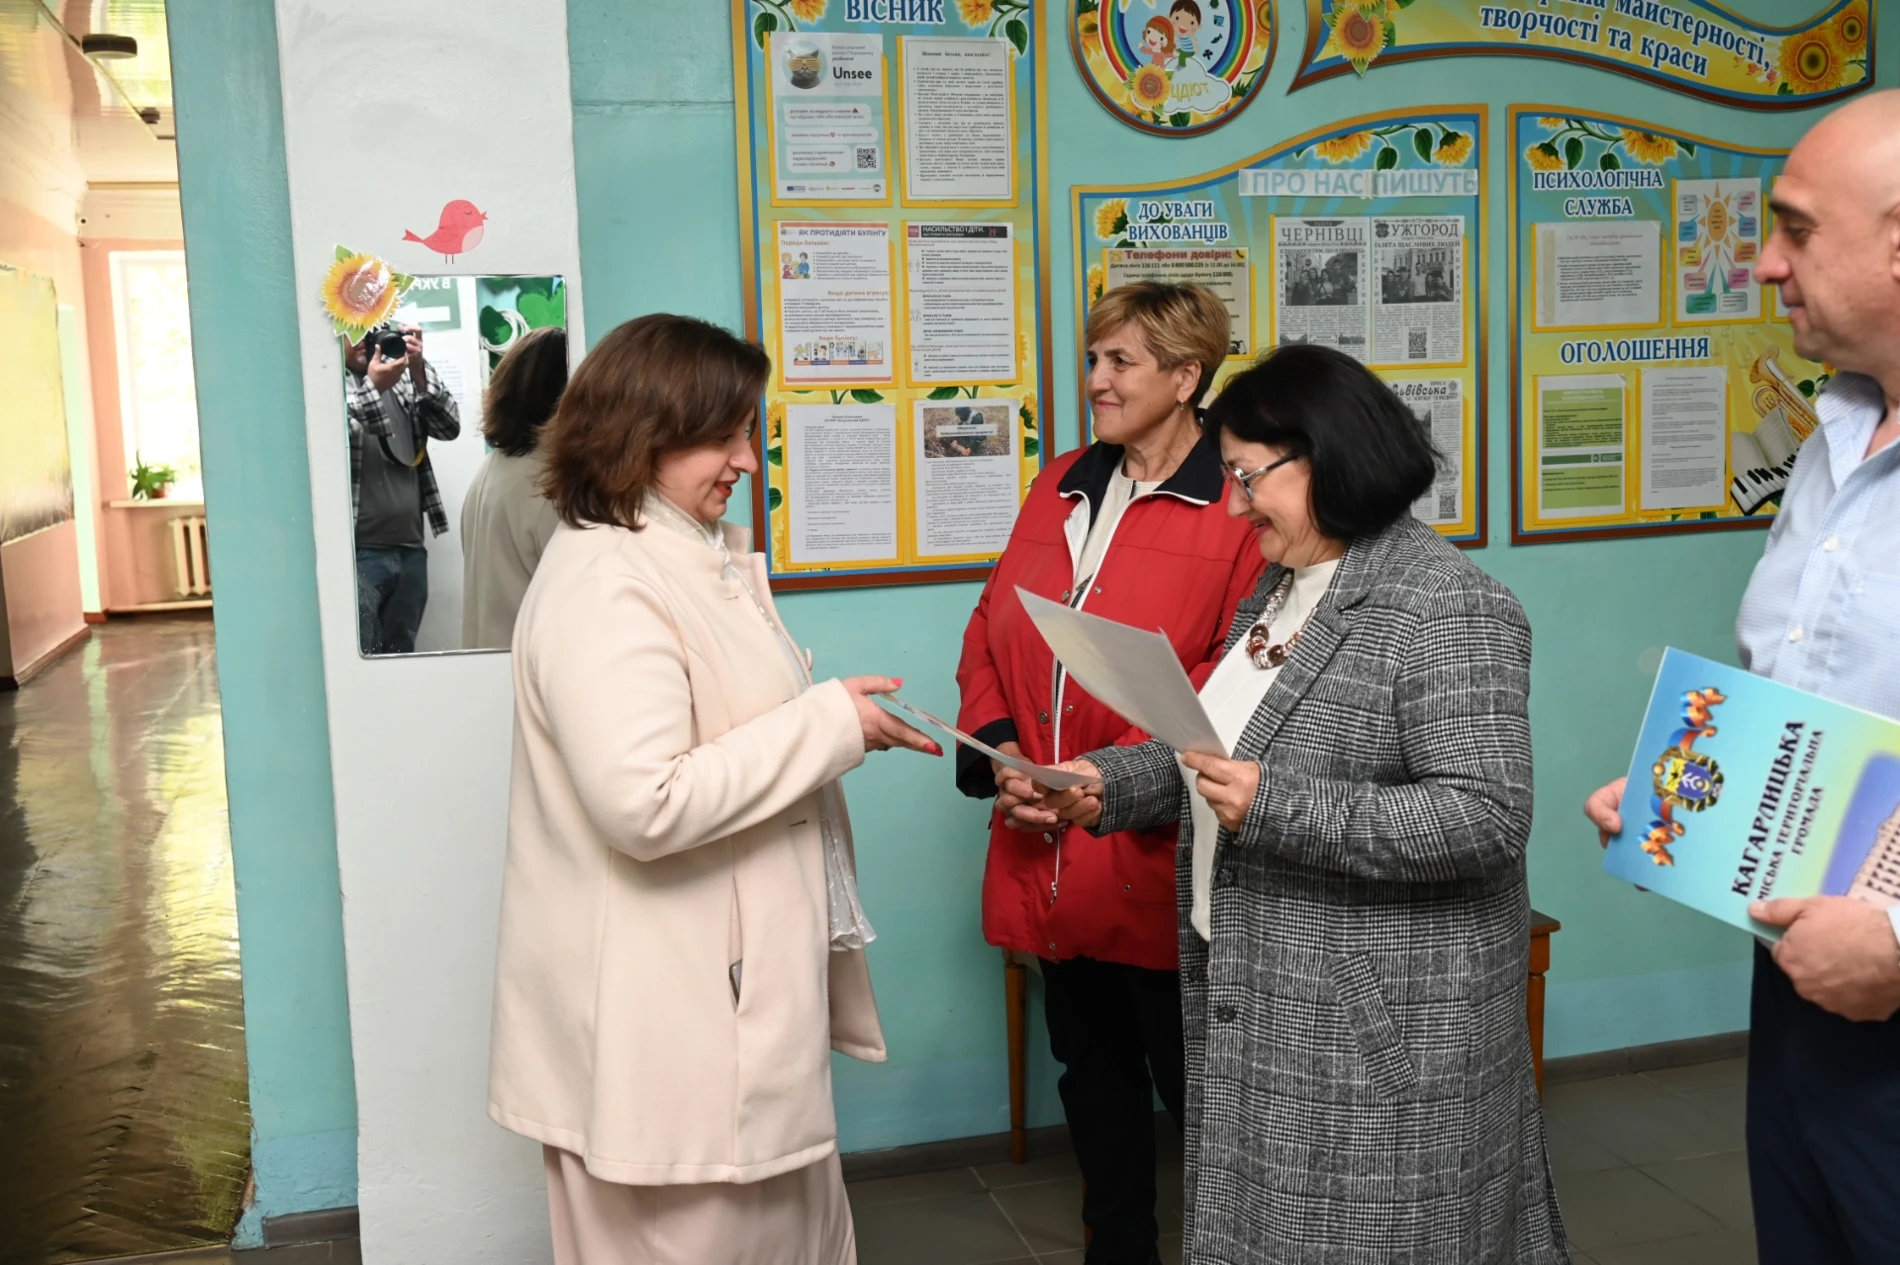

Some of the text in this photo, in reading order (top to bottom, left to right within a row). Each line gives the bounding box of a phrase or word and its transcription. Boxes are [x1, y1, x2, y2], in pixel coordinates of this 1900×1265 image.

[846, 0, 944, 22] ВІСНИК
[1481, 7, 1708, 76] творчості та краси
[832, 66, 873, 79] Unsee
[1171, 82, 1210, 103] ЦДЮТ
[1252, 171, 1478, 194] ПРО НАС ПИШУТЬ
[1533, 170, 1663, 189] ПСИХОЛОГІЧНА
[1138, 202, 1213, 220] ДО УВАГИ
[1564, 198, 1634, 216] СЛУЖБА
[1128, 224, 1228, 243] ВИХОВАНЦІВ
[1281, 227, 1363, 242] ЧЕРНІВЦІ
[1391, 223, 1459, 237] УЖГОРОД
[1124, 249, 1232, 261] Телефони довіри:
[1560, 337, 1710, 364] ОГОЛОШЕННЯ
[1732, 721, 1806, 898] КАГАРЛИЦЬКА
[1757, 730, 1824, 902] МІСЬКА ТЕРИТОРІАЛЬНА
[1791, 786, 1823, 855] ГРОМАДА
